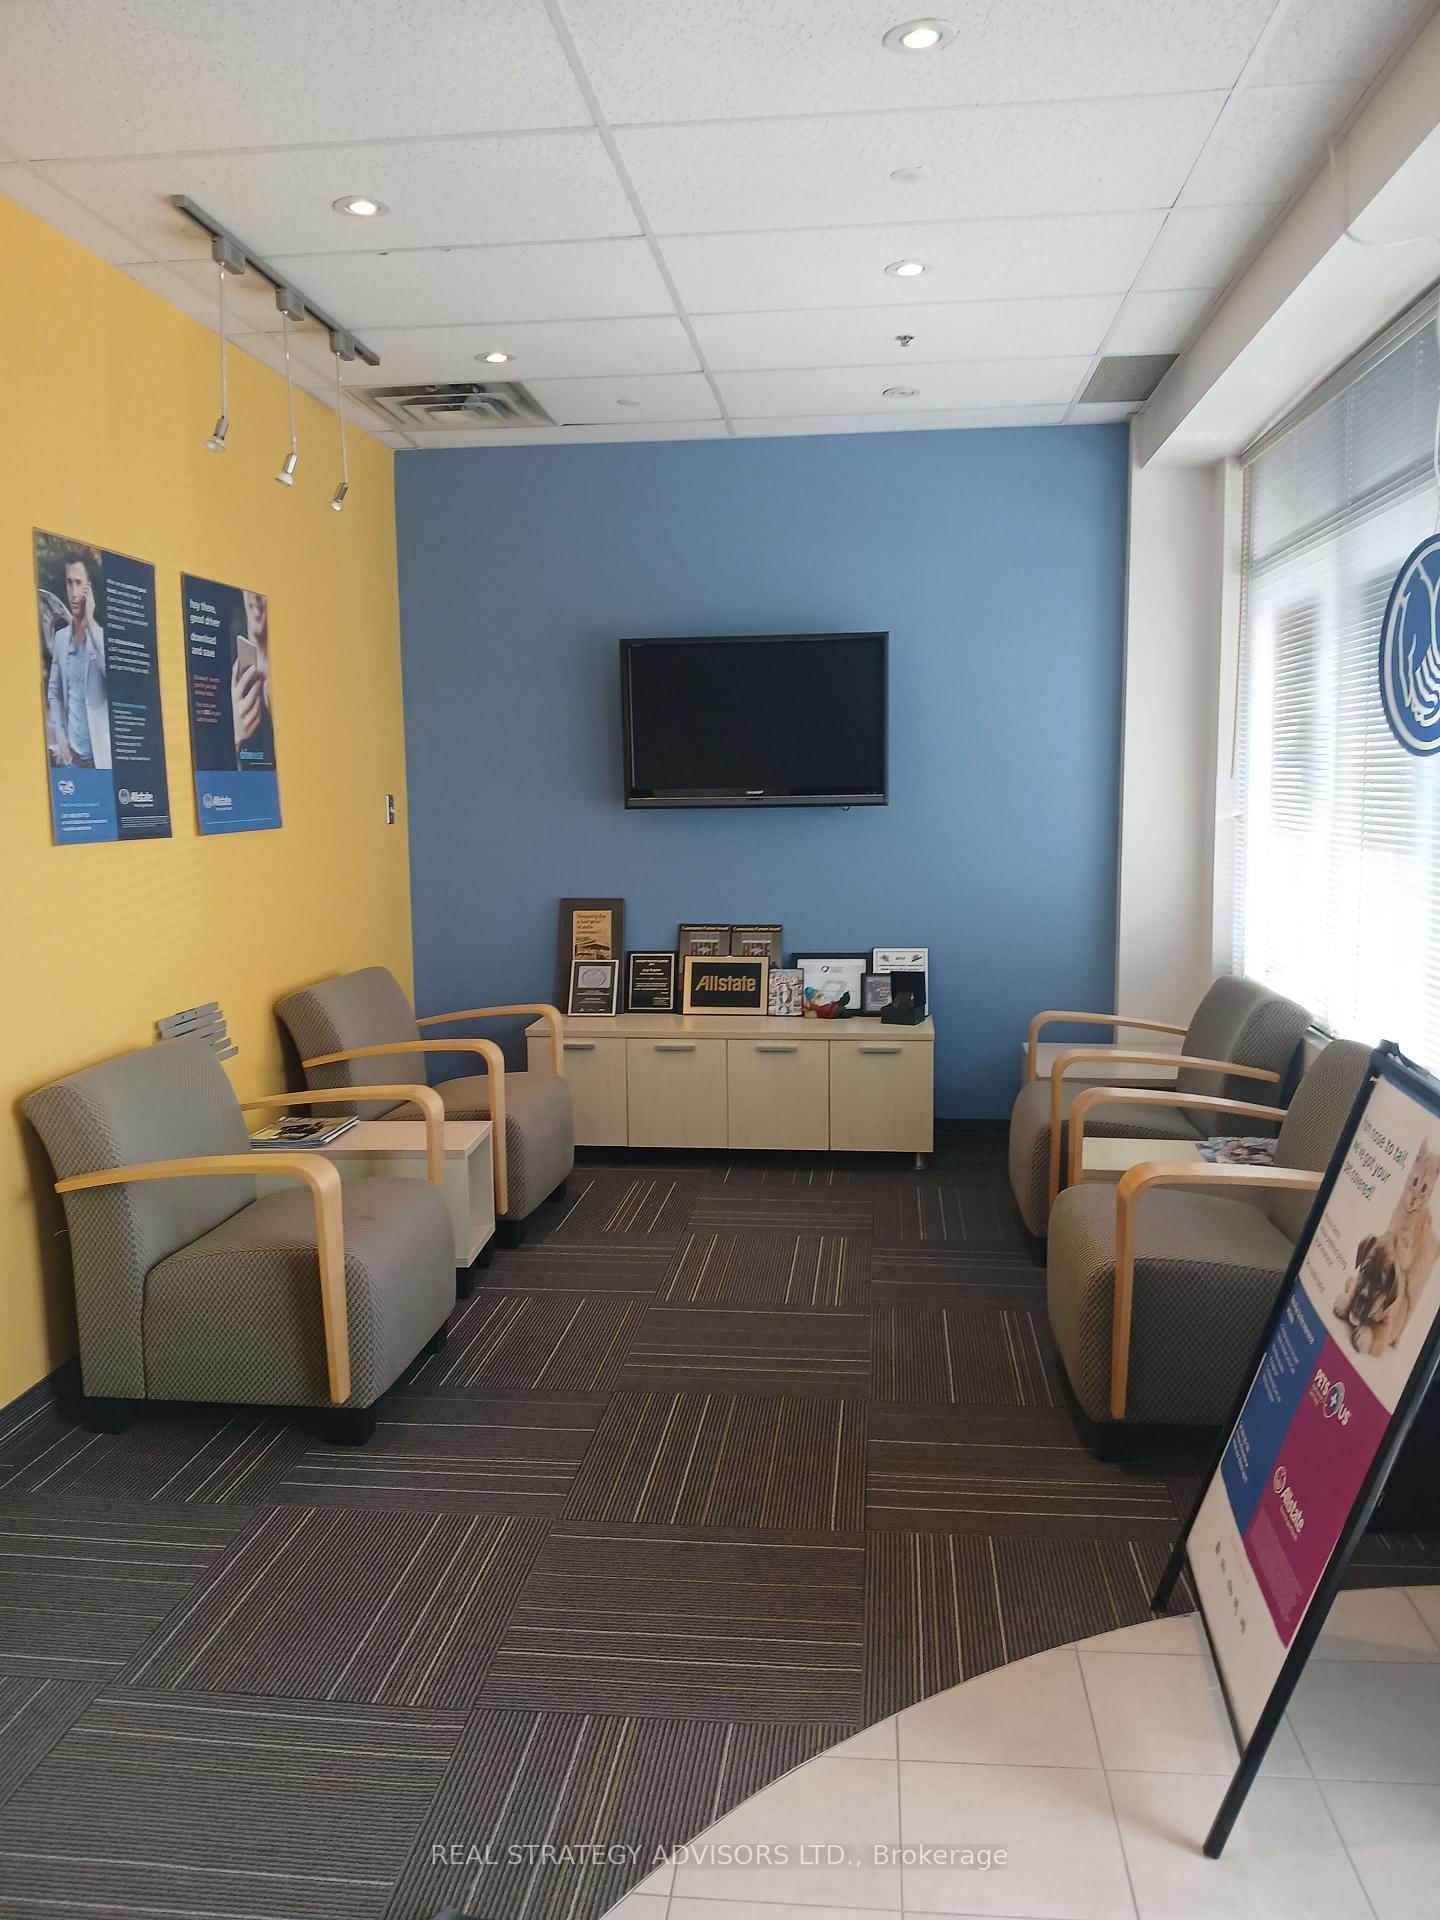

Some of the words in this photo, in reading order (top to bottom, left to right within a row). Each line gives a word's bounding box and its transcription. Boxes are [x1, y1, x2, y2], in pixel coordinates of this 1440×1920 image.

[696, 975, 756, 992] Allstate
[1385, 1139, 1395, 1156] to
[1371, 1162, 1391, 1184] your
[1313, 1368, 1331, 1396] PETS
